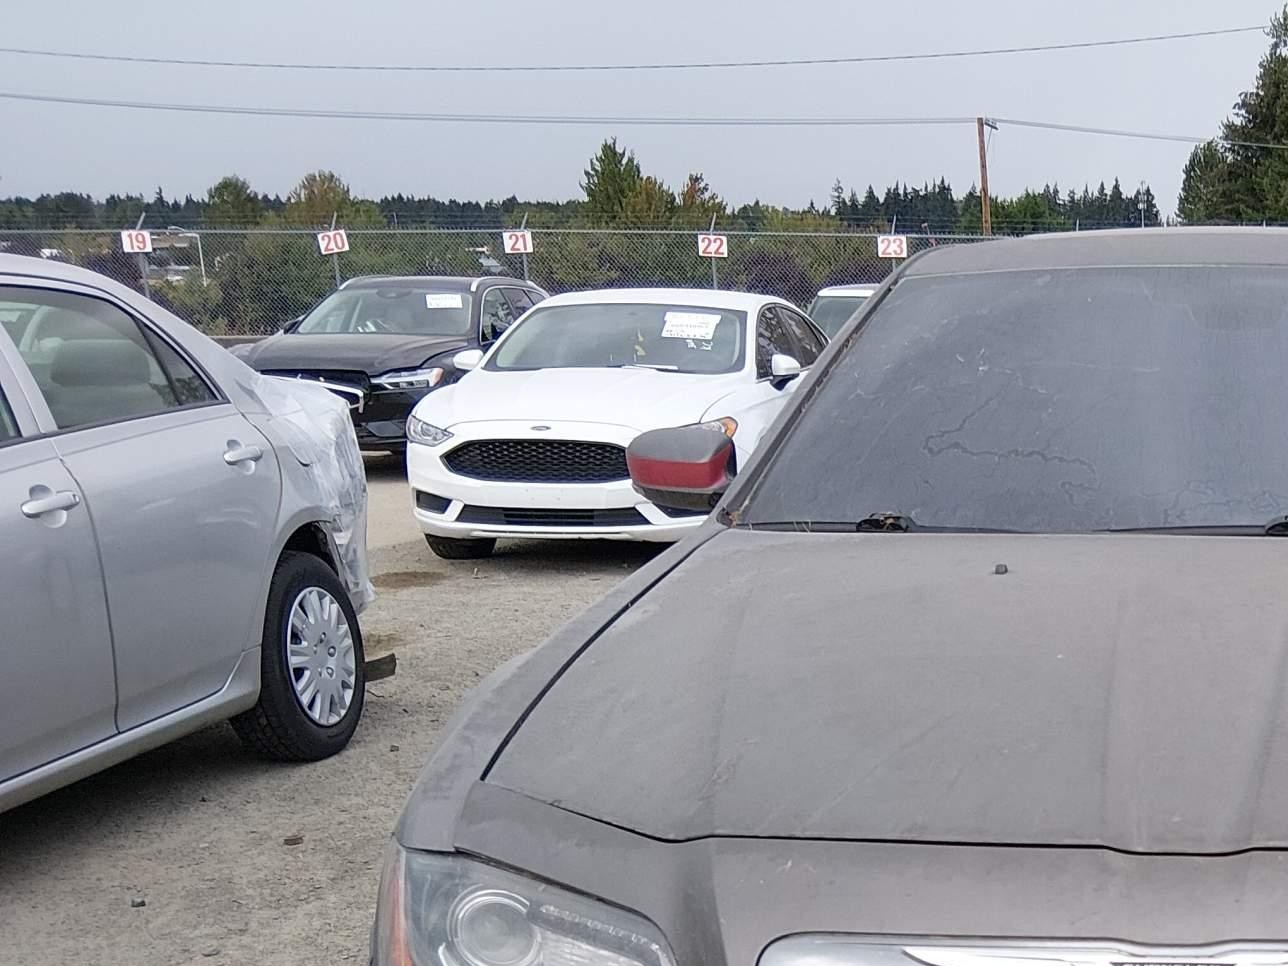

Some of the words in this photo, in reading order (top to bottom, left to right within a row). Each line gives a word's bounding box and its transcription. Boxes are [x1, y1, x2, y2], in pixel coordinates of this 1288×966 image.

[127, 233, 147, 250] 19
[321, 232, 346, 252] 20
[508, 233, 528, 251] 21
[701, 236, 725, 255] 22
[880, 238, 904, 256] 23
